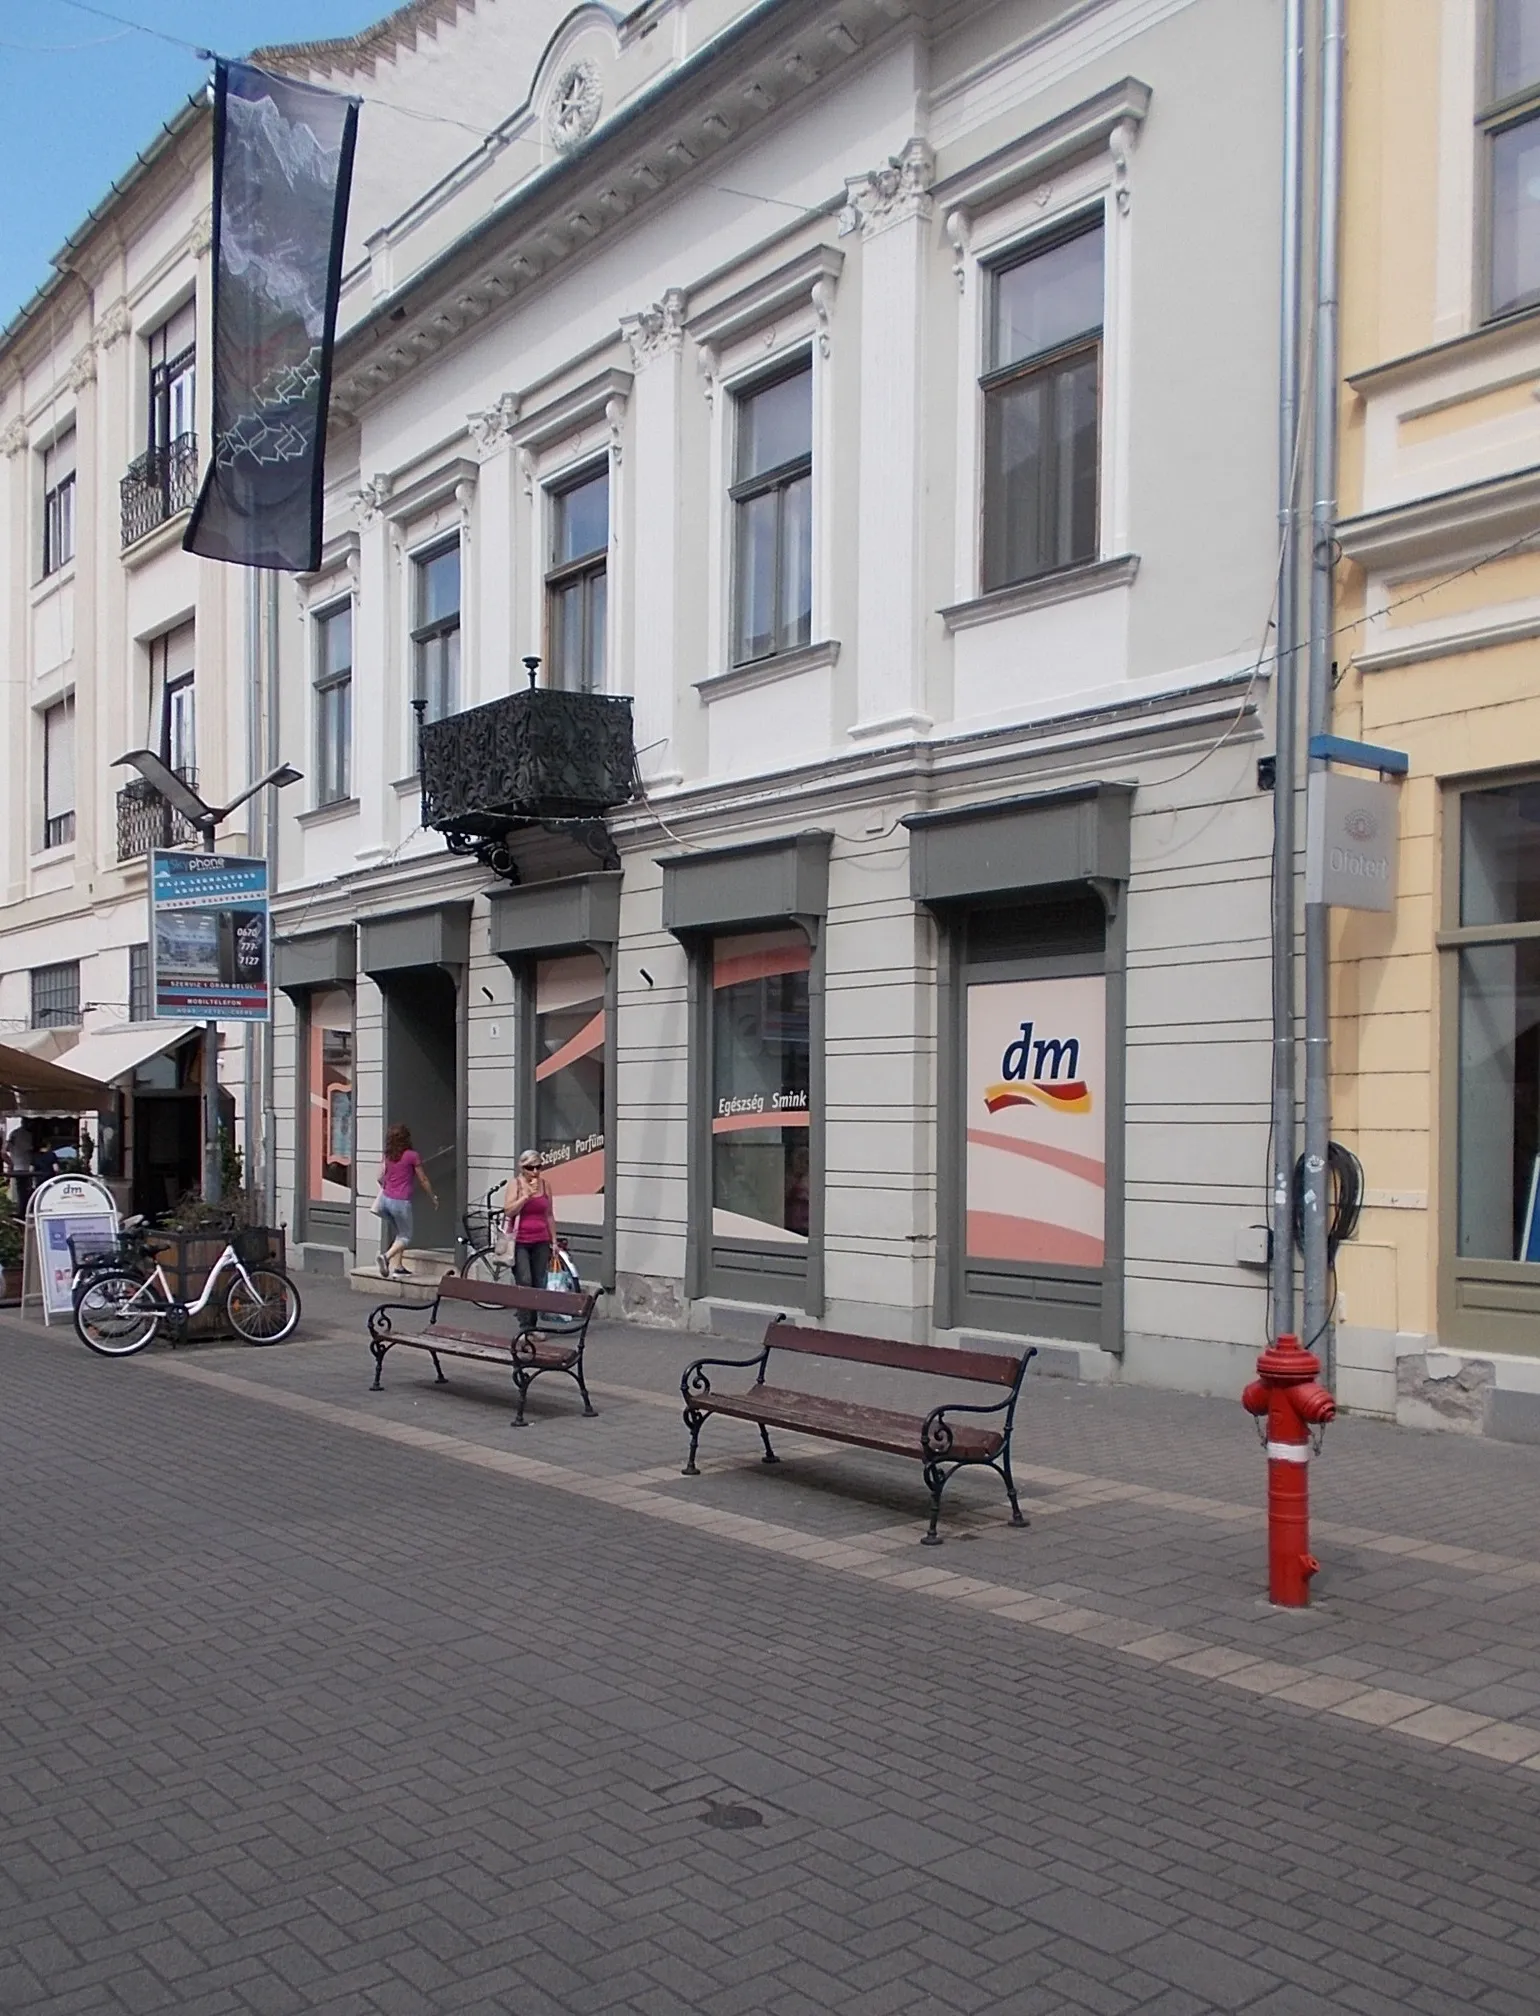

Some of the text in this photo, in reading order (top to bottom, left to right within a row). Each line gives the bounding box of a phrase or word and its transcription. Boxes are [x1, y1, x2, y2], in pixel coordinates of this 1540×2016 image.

[240, 956, 260, 966] 7127
[170, 980, 201, 988] SZERVIZ
[187, 998, 242, 1006] MOBILTELEFON
[1002, 1021, 1080, 1081] dm
[718, 1089, 807, 1117] Egészség Smink
[540, 1133, 604, 1165] Szépség Parfüm
[63, 1184, 82, 1194] dm
